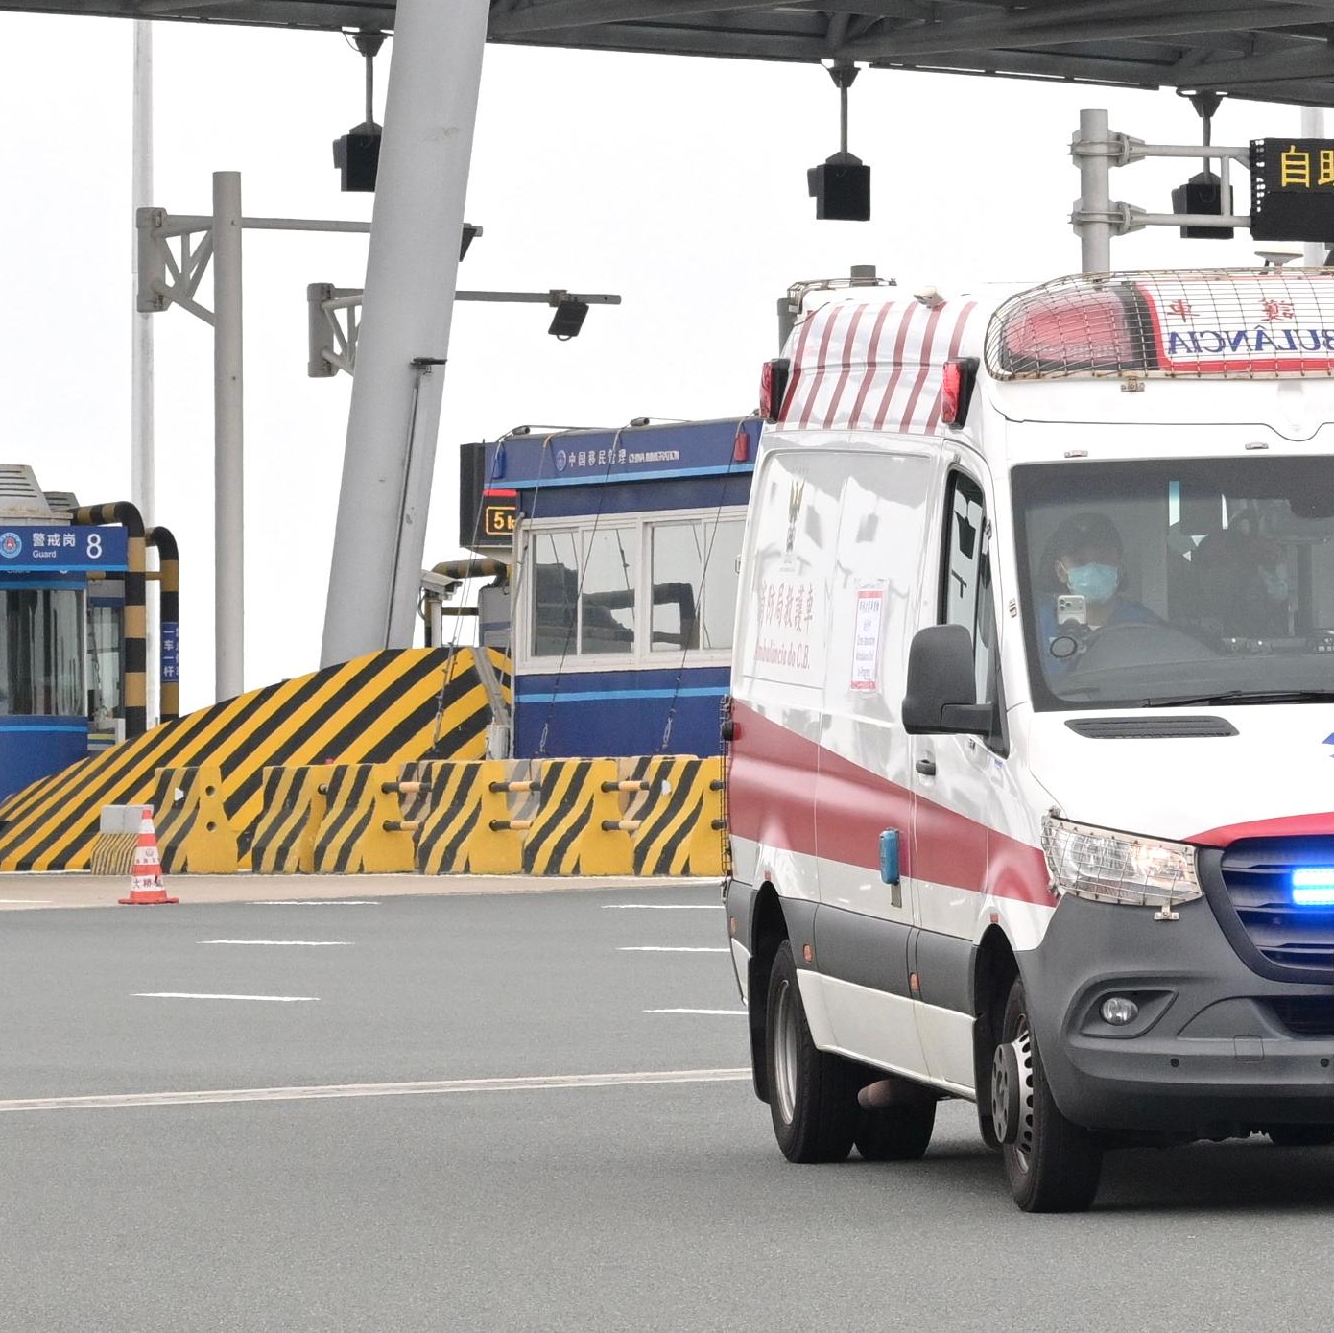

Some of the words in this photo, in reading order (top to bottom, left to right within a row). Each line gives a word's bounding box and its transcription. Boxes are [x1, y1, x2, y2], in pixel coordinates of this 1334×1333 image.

[32, 533, 76, 547] 警戒岗
[86, 533, 103, 560] 8
[32, 550, 57, 559] Guard
